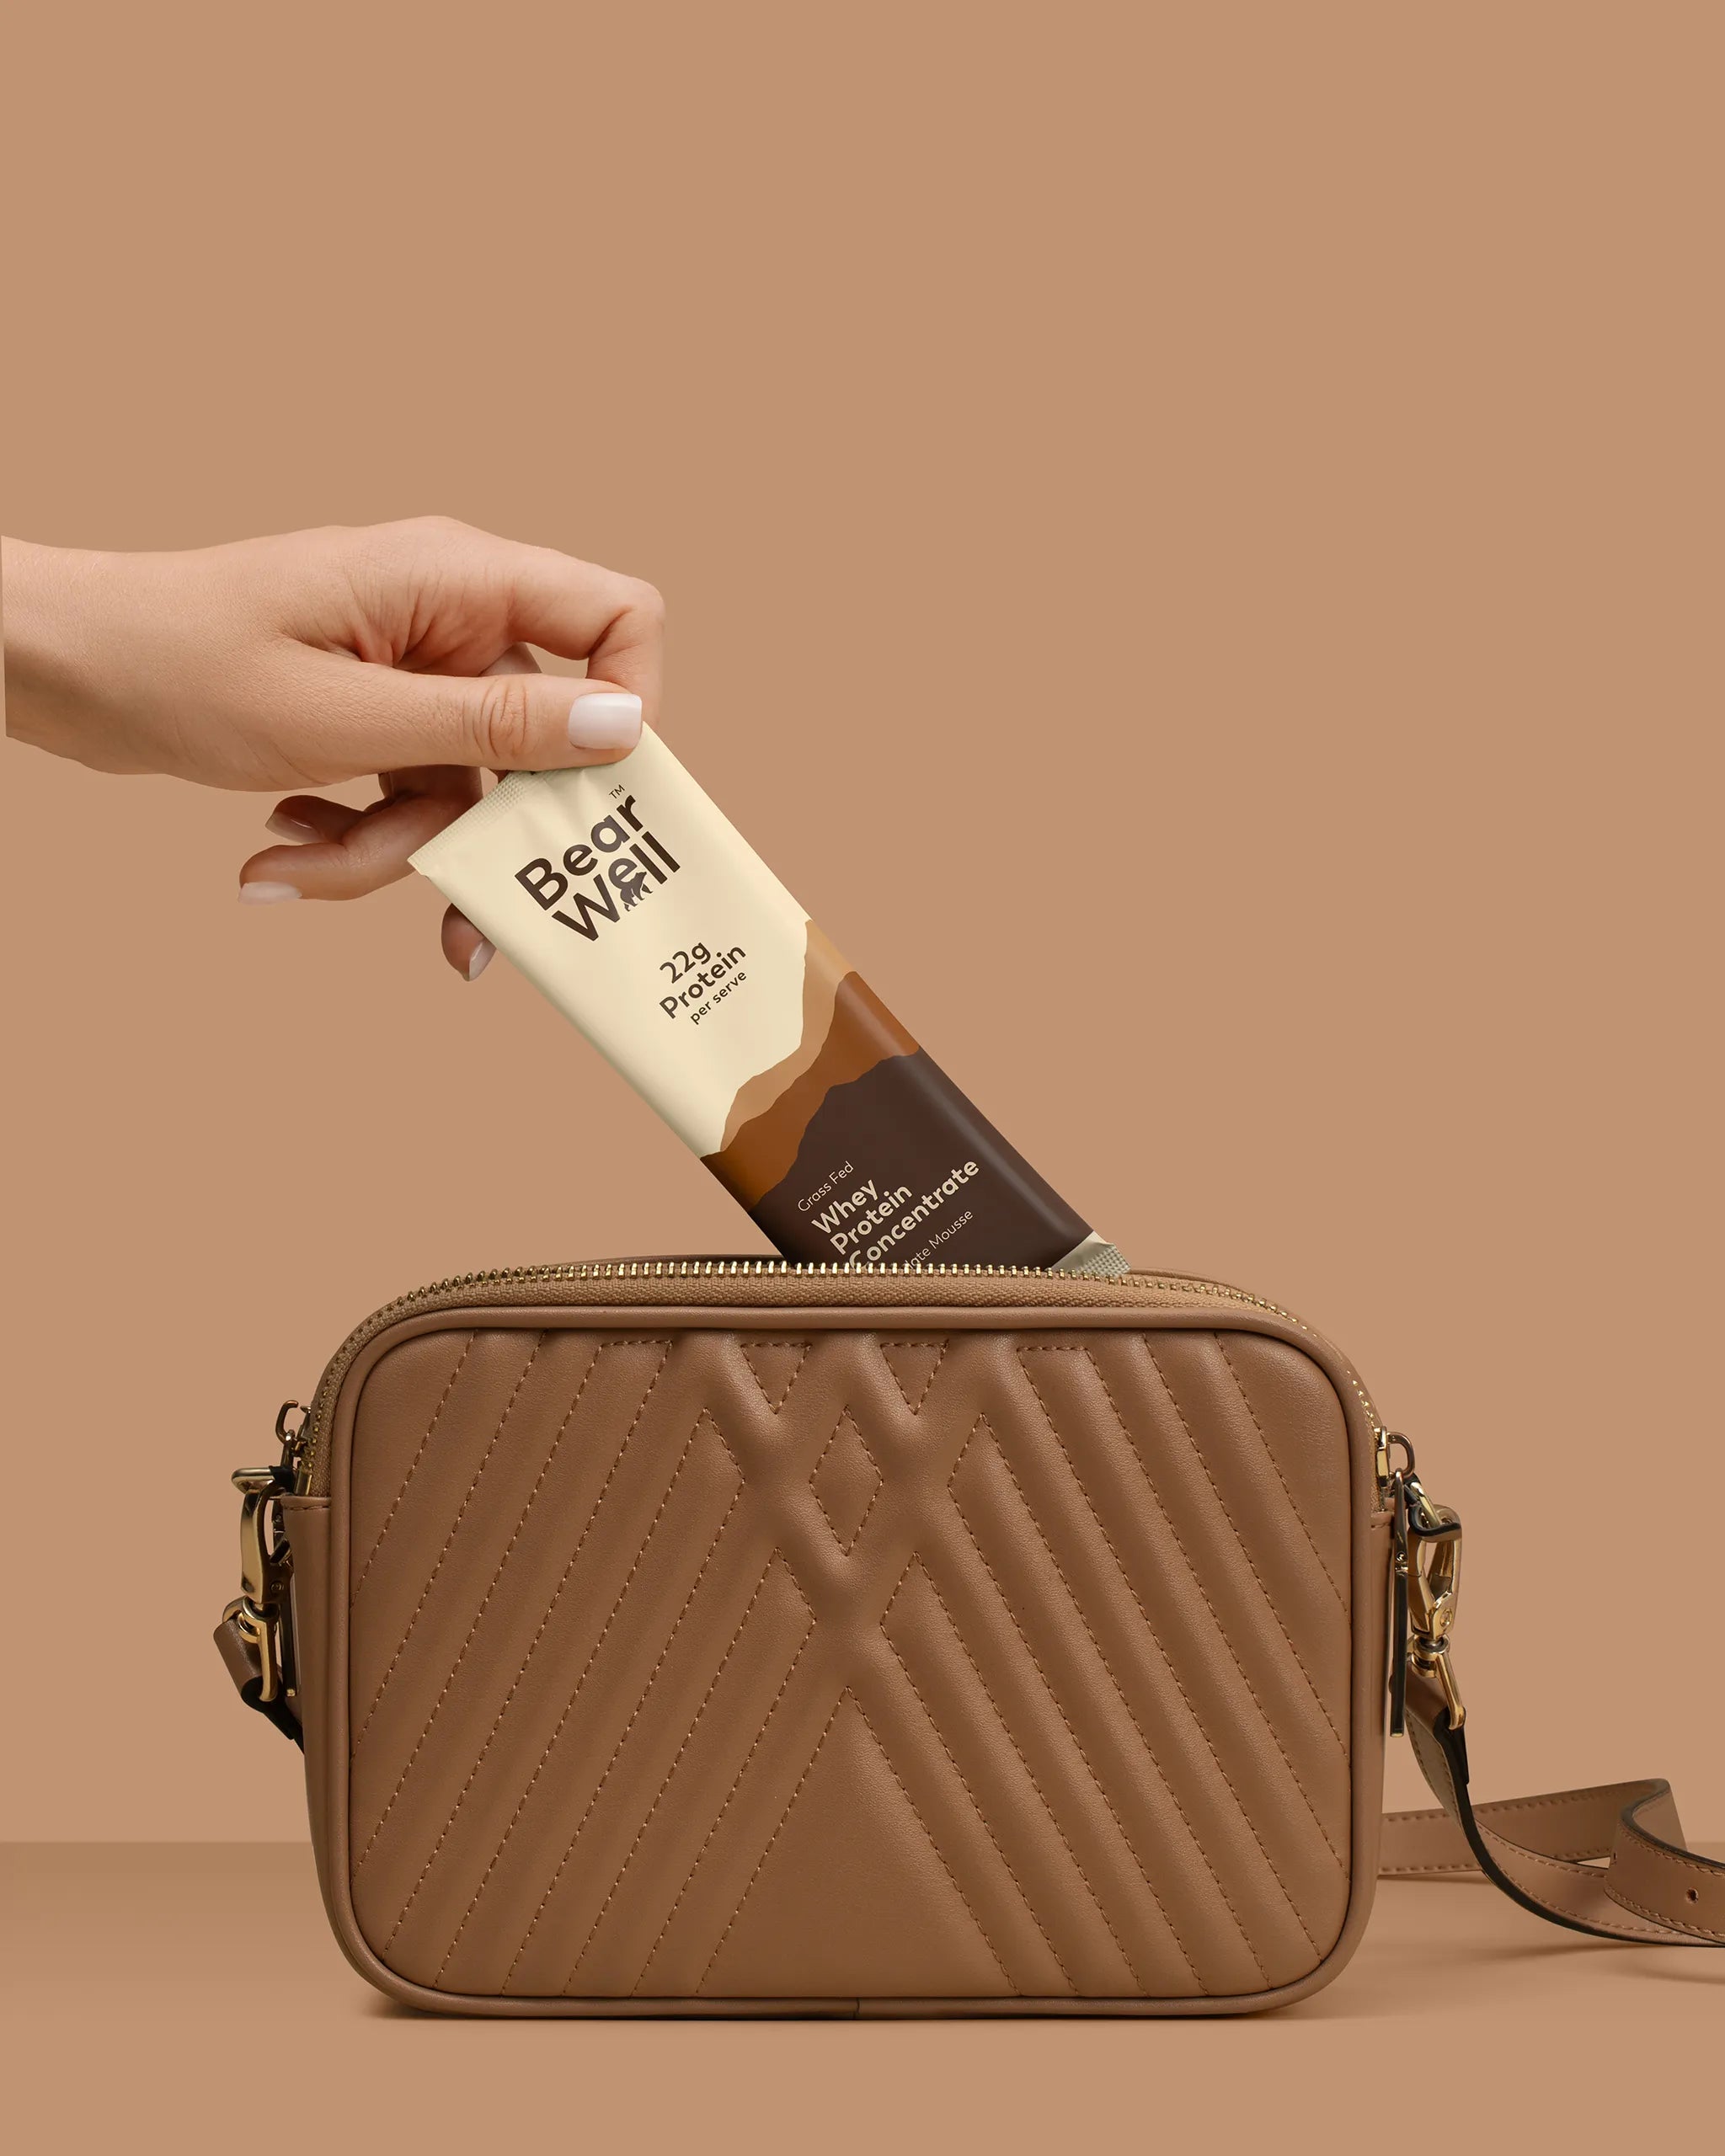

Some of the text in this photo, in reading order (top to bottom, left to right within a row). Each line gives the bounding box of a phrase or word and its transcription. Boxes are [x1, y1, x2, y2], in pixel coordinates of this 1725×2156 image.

[515, 795, 644, 910] Bear
[551, 831, 681, 942] Well
[659, 947, 746, 1019] Protein
[660, 942, 711, 984] 22g
[690, 972, 746, 1025] per serve
[798, 1161, 854, 1211] Grass Fed
[811, 1179, 878, 1234] Whey
[849, 1161, 979, 1269] Concentrate
[830, 1186, 912, 1255] Protein
[928, 1211, 973, 1249] Mousse
